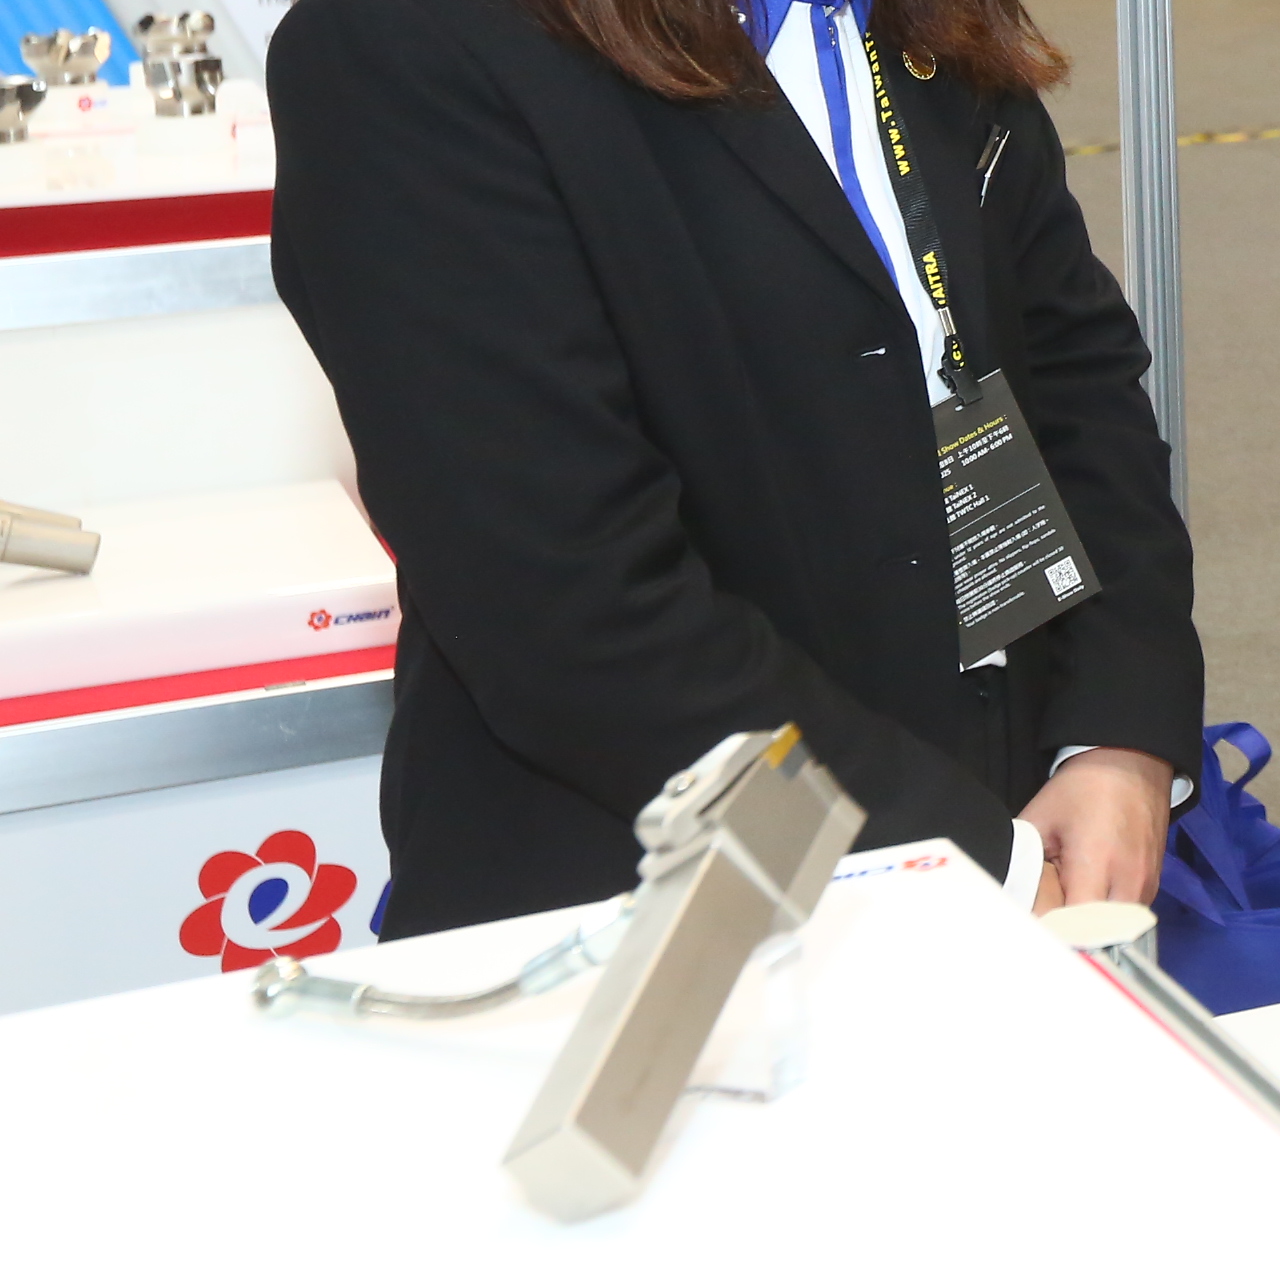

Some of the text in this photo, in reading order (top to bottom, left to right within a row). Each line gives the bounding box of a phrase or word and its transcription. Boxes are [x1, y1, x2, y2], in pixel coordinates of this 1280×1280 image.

[941, 416, 1004, 455] Show Dates & Hours
[961, 453, 978, 467] 10:00
[990, 439, 1003, 451] 6:00
[1002, 433, 1014, 444] PM
